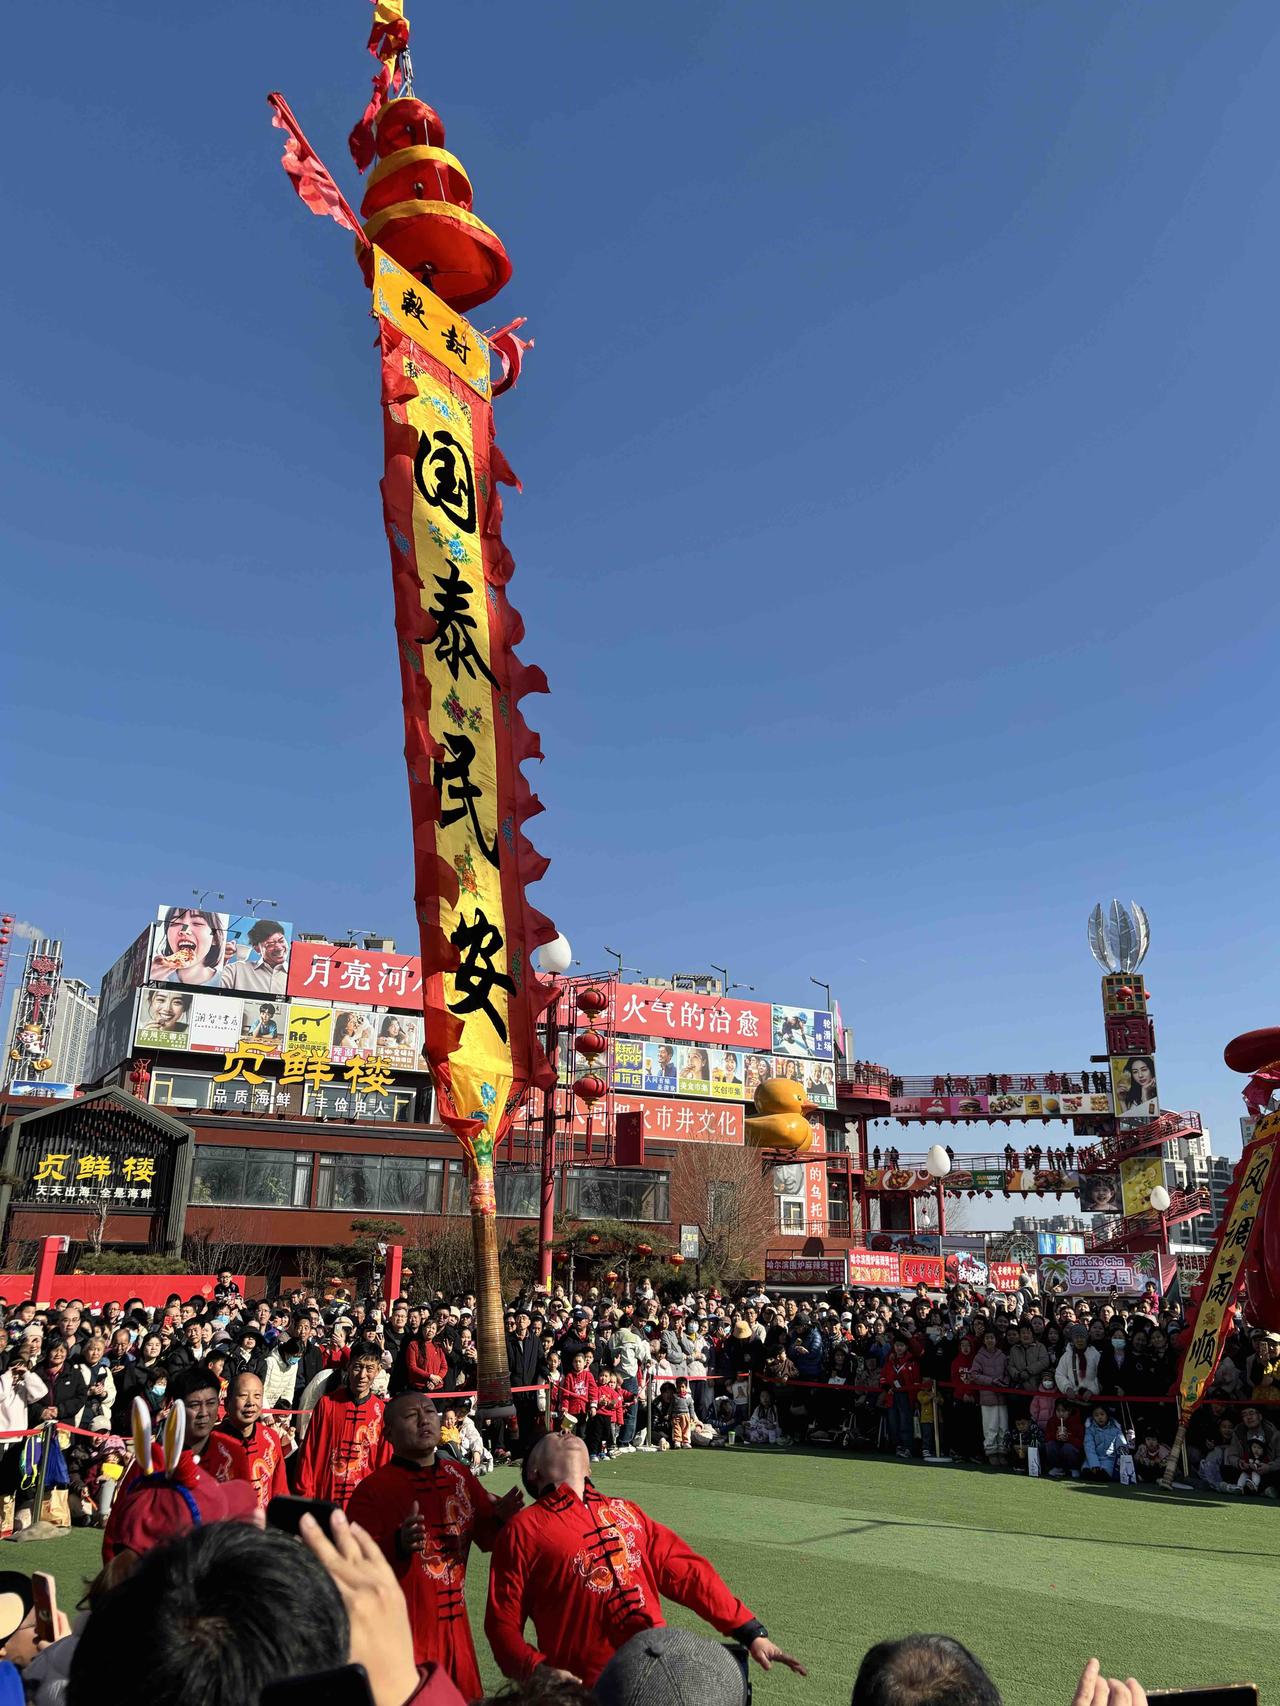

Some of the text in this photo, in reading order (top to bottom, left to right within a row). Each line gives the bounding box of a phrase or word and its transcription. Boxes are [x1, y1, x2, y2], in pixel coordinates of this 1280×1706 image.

[303, 954, 422, 996] 月亮河
[288, 1030, 308, 1042] Ré
[822, 1019, 832, 1052] 轮滑场
[615, 1053, 642, 1067] Kpop
[213, 1089, 387, 1115] 品质海鲜 丰俭由人
[809, 1114, 824, 1236] 创业的乌托邦
[36, 1185, 91, 1197] 天天出海
[1105, 1257, 1124, 1267] Cha
[1070, 1268, 1132, 1285] 泰可茶园
